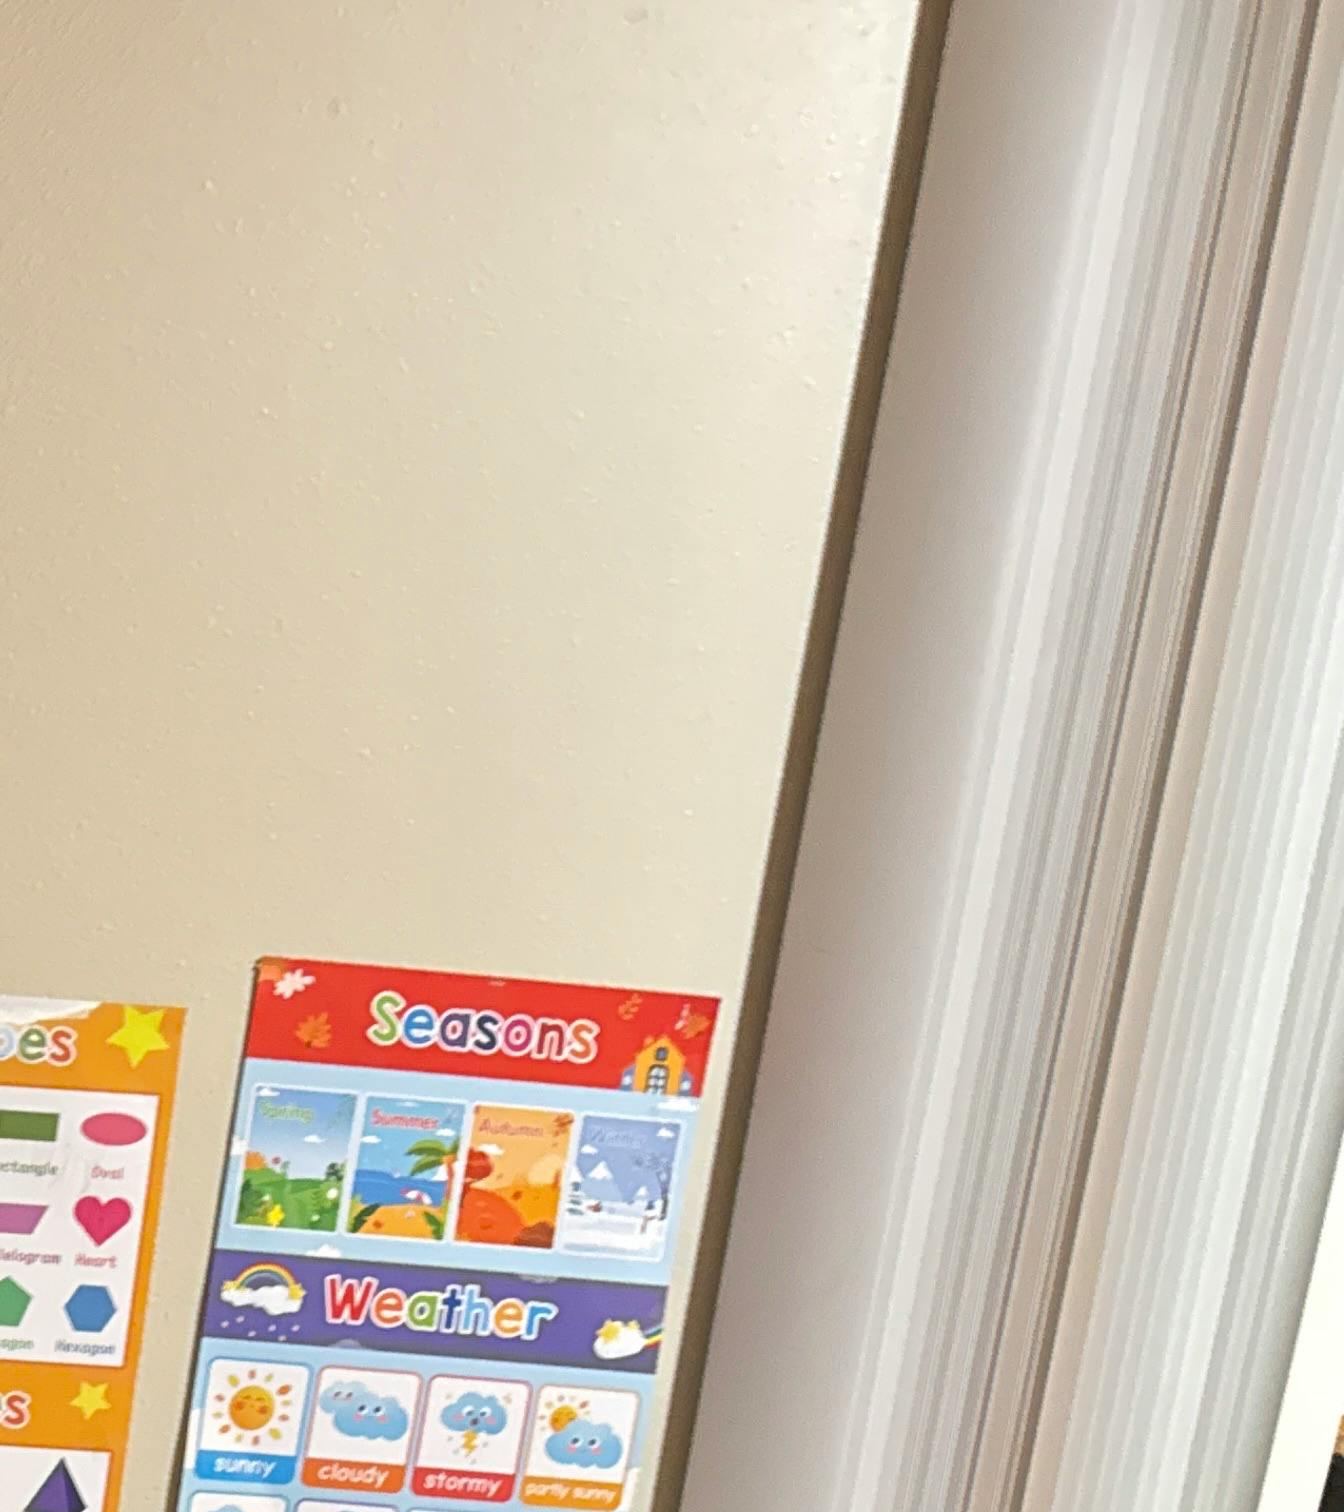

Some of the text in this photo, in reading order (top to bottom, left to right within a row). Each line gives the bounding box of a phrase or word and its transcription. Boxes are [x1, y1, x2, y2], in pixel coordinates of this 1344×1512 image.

[369, 991, 600, 1063] Seasons
[371, 1109, 439, 1130] Summer
[478, 1118, 544, 1137] Autumn
[74, 1253, 118, 1268] Heart
[323, 1274, 558, 1342] Weather
[212, 1455, 276, 1480] sunny
[316, 1463, 389, 1488] cloudy
[422, 1473, 503, 1497] stormy
[524, 1480, 618, 1504] partly sunny
